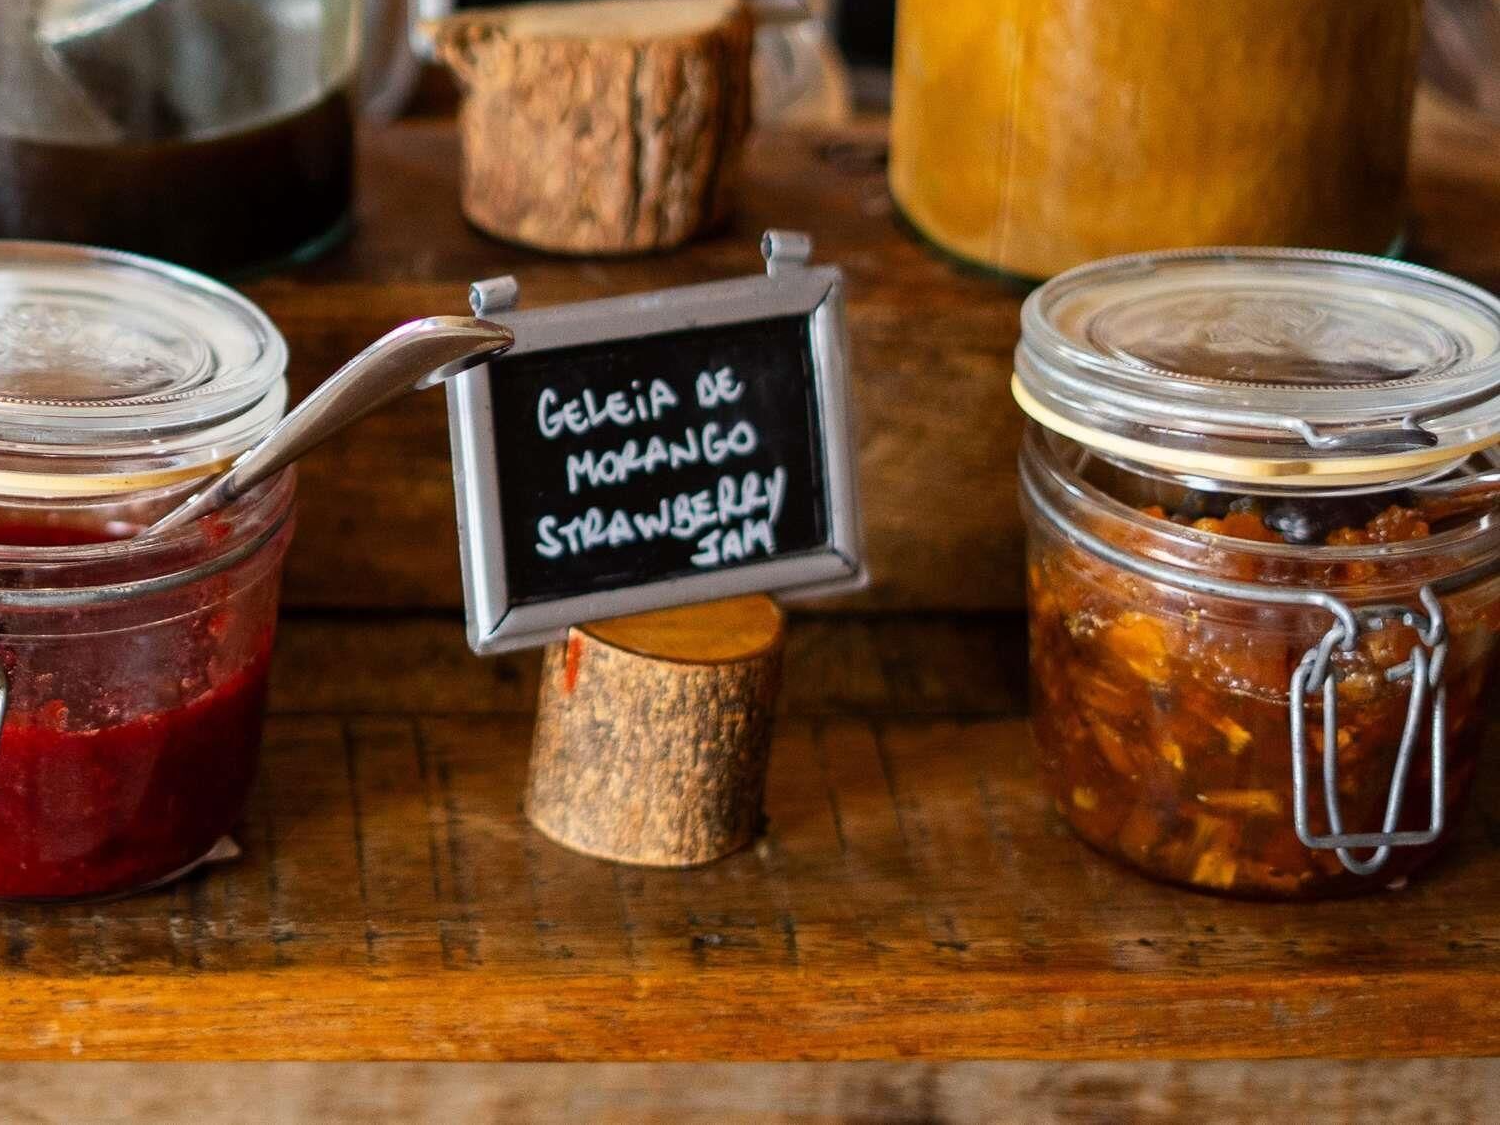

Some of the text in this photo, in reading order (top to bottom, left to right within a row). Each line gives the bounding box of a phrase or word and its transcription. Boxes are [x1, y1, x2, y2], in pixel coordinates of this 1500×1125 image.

[695, 366, 744, 408] DE
[566, 420, 757, 494] MORANGO
[535, 466, 787, 558] STRAWBERRY
[690, 520, 776, 567] JAM
